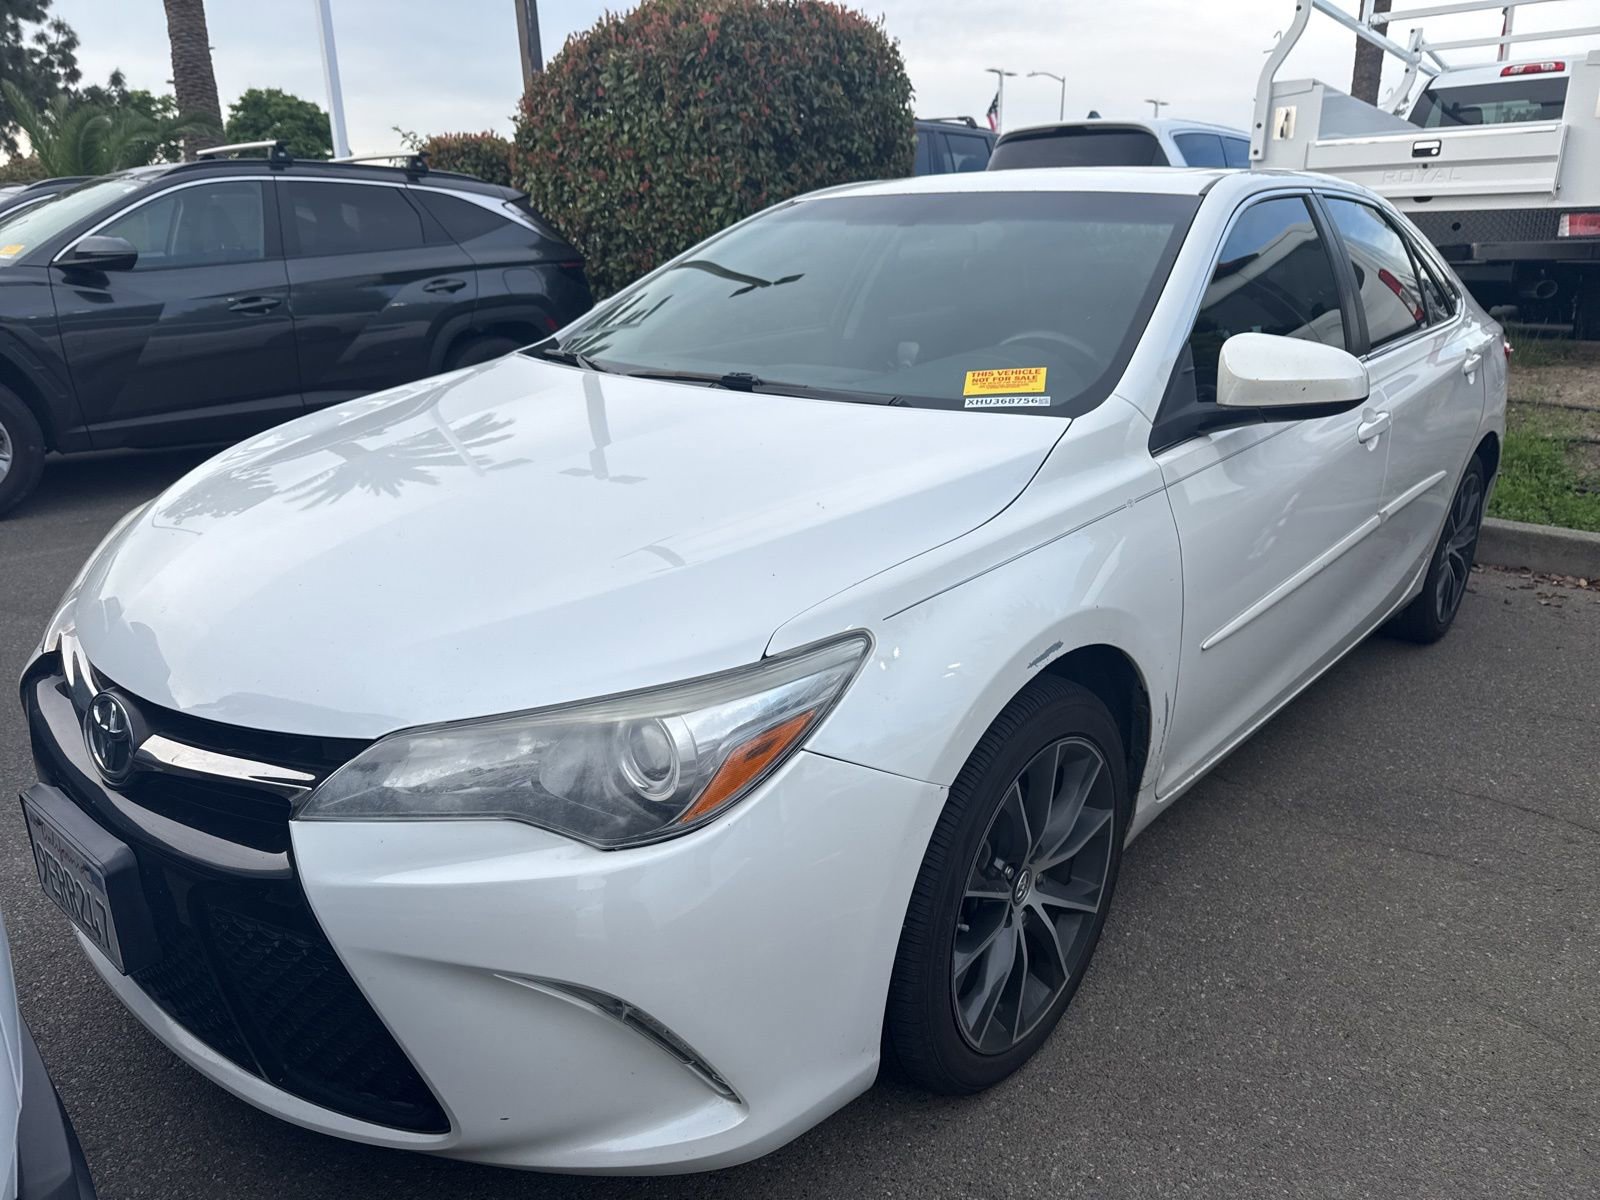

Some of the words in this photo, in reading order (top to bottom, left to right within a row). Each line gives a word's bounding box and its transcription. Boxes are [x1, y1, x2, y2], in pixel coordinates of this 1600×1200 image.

[1382, 167, 1462, 183] ROYAL
[997, 368, 1041, 376] VEHICLE
[966, 397, 1038, 406] XHU368756
[36, 841, 111, 951] 9ERR247
